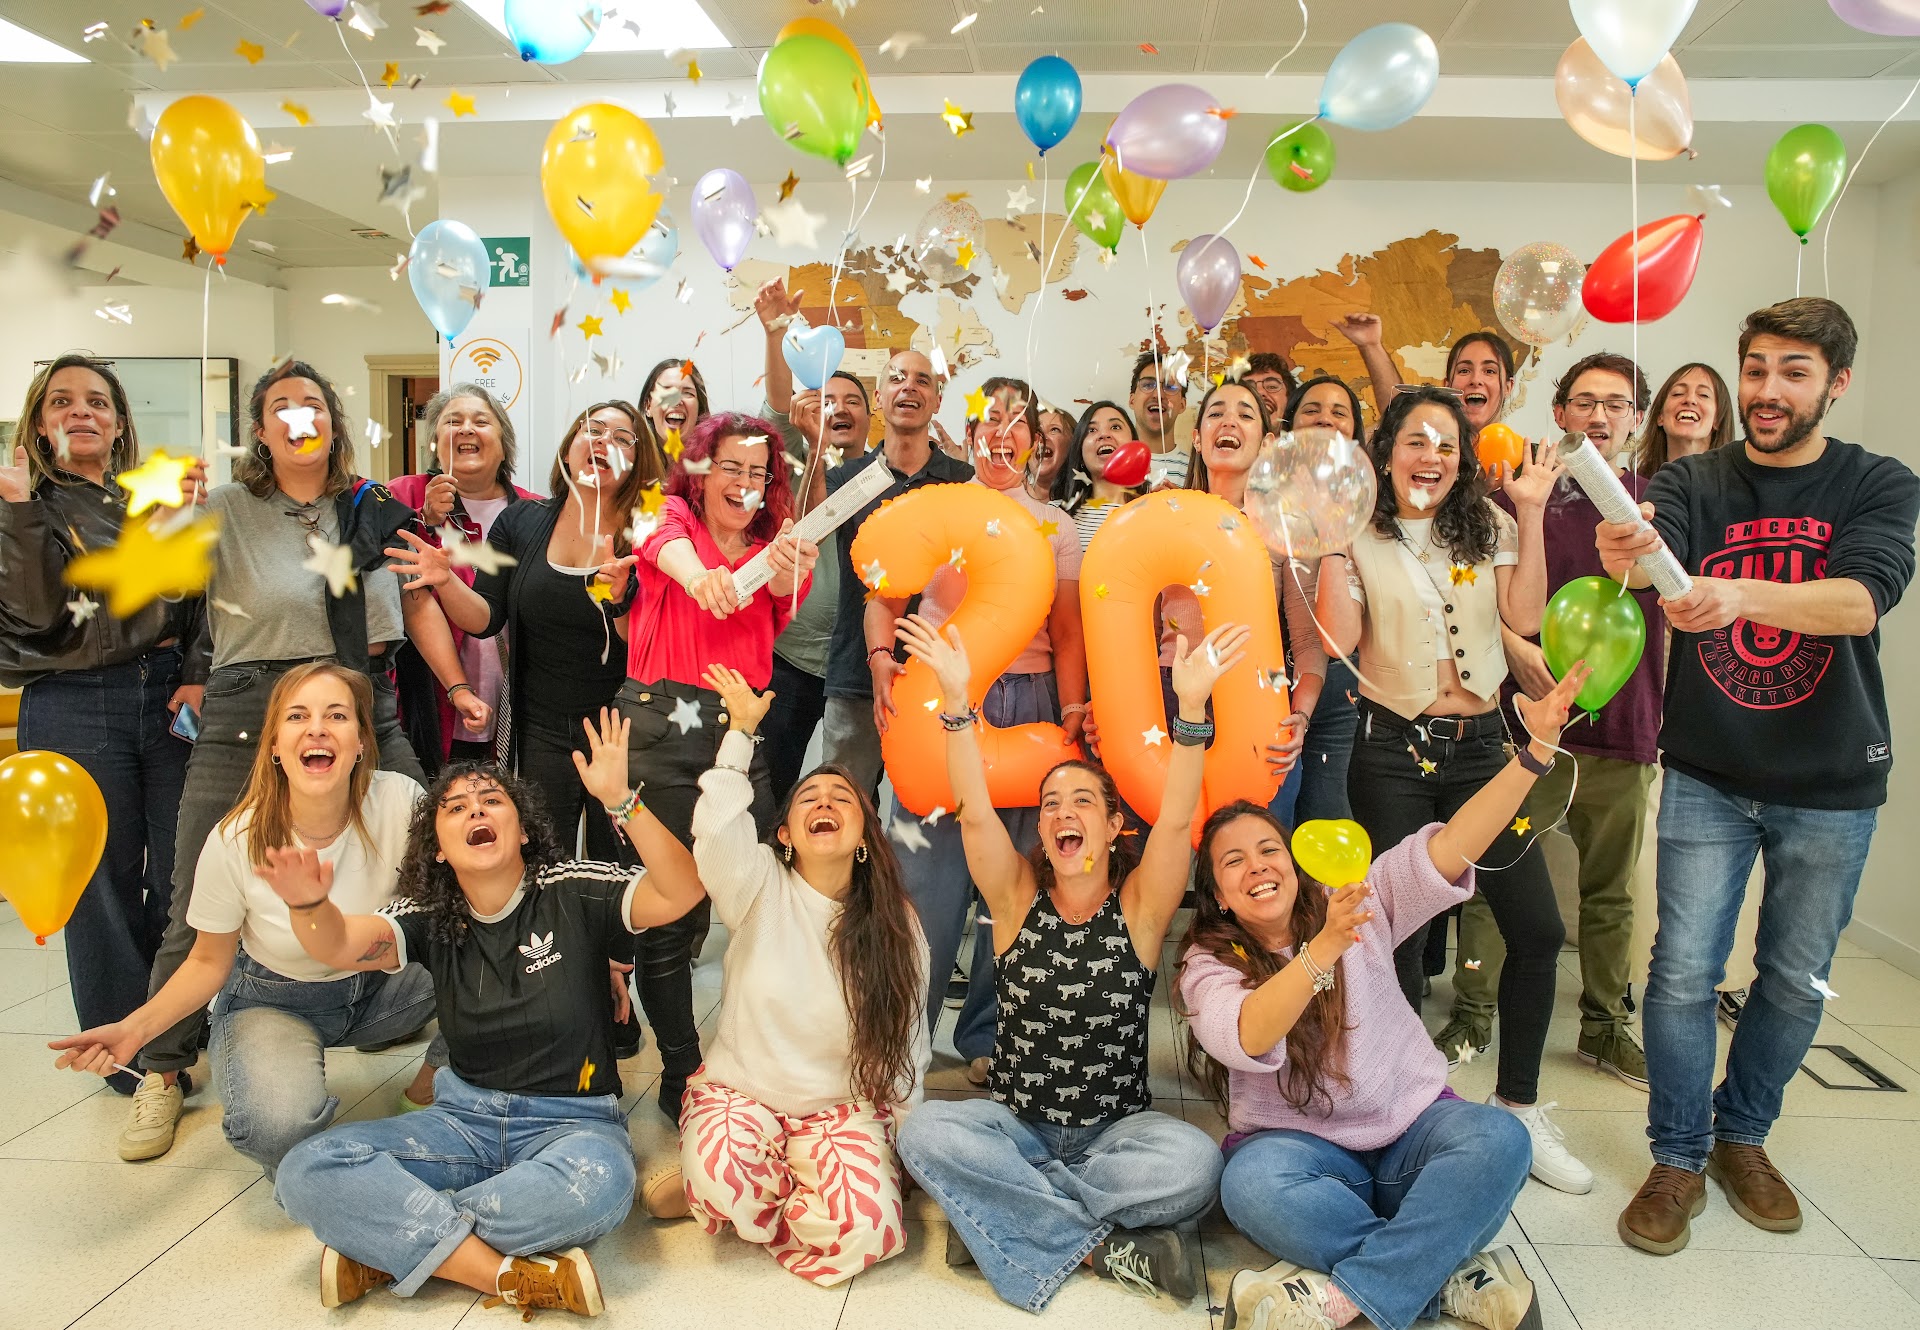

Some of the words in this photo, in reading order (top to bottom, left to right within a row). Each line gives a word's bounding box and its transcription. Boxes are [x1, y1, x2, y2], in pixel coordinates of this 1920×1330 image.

[1727, 519, 1827, 540] CHICAGO
[1713, 629, 1774, 685] CHICAGO
[525, 951, 563, 974] adidas
